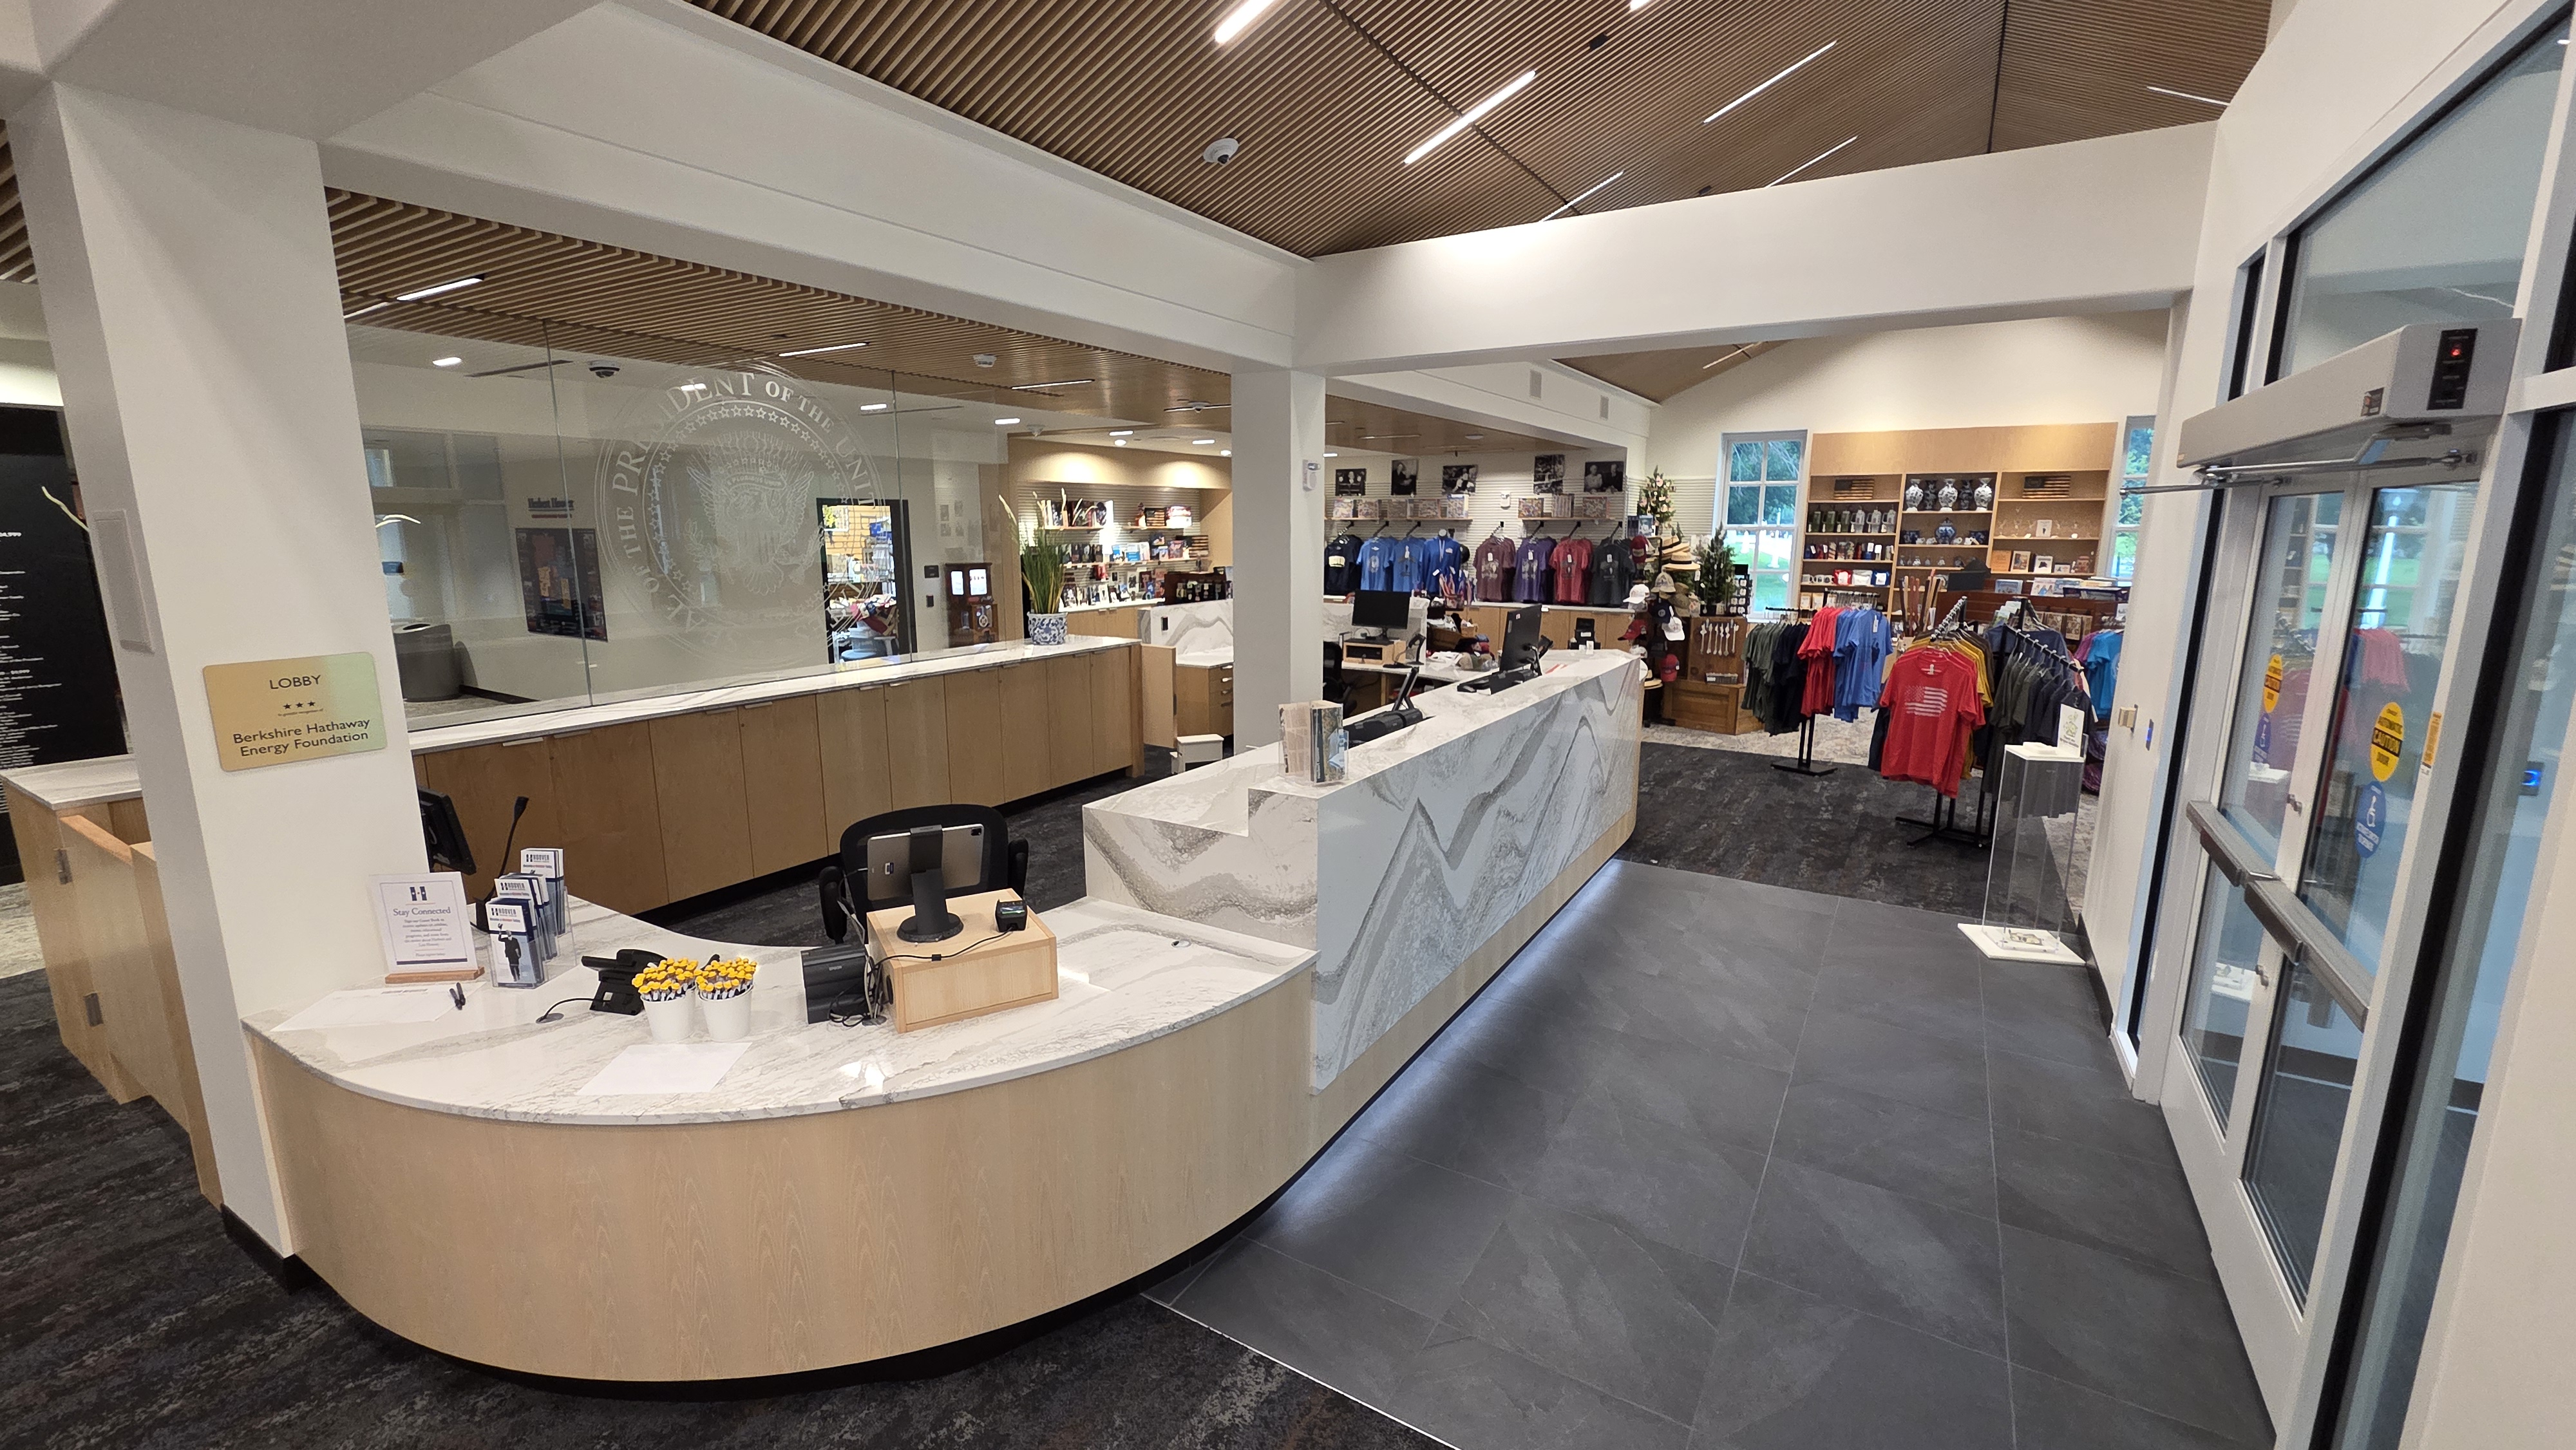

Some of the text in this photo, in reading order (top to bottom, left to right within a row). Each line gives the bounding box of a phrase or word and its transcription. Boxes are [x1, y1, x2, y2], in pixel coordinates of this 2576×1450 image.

[616, 506, 643, 559] THE
[765, 381, 794, 402] OF
[798, 395, 835, 434] THE
[269, 675, 321, 690] LOBBY
[233, 719, 370, 744] Berkshire Hathaway
[2372, 730, 2400, 755] CAUTION
[240, 732, 369, 757] Energy Foundation
[393, 907, 451, 918] Stay Connected
